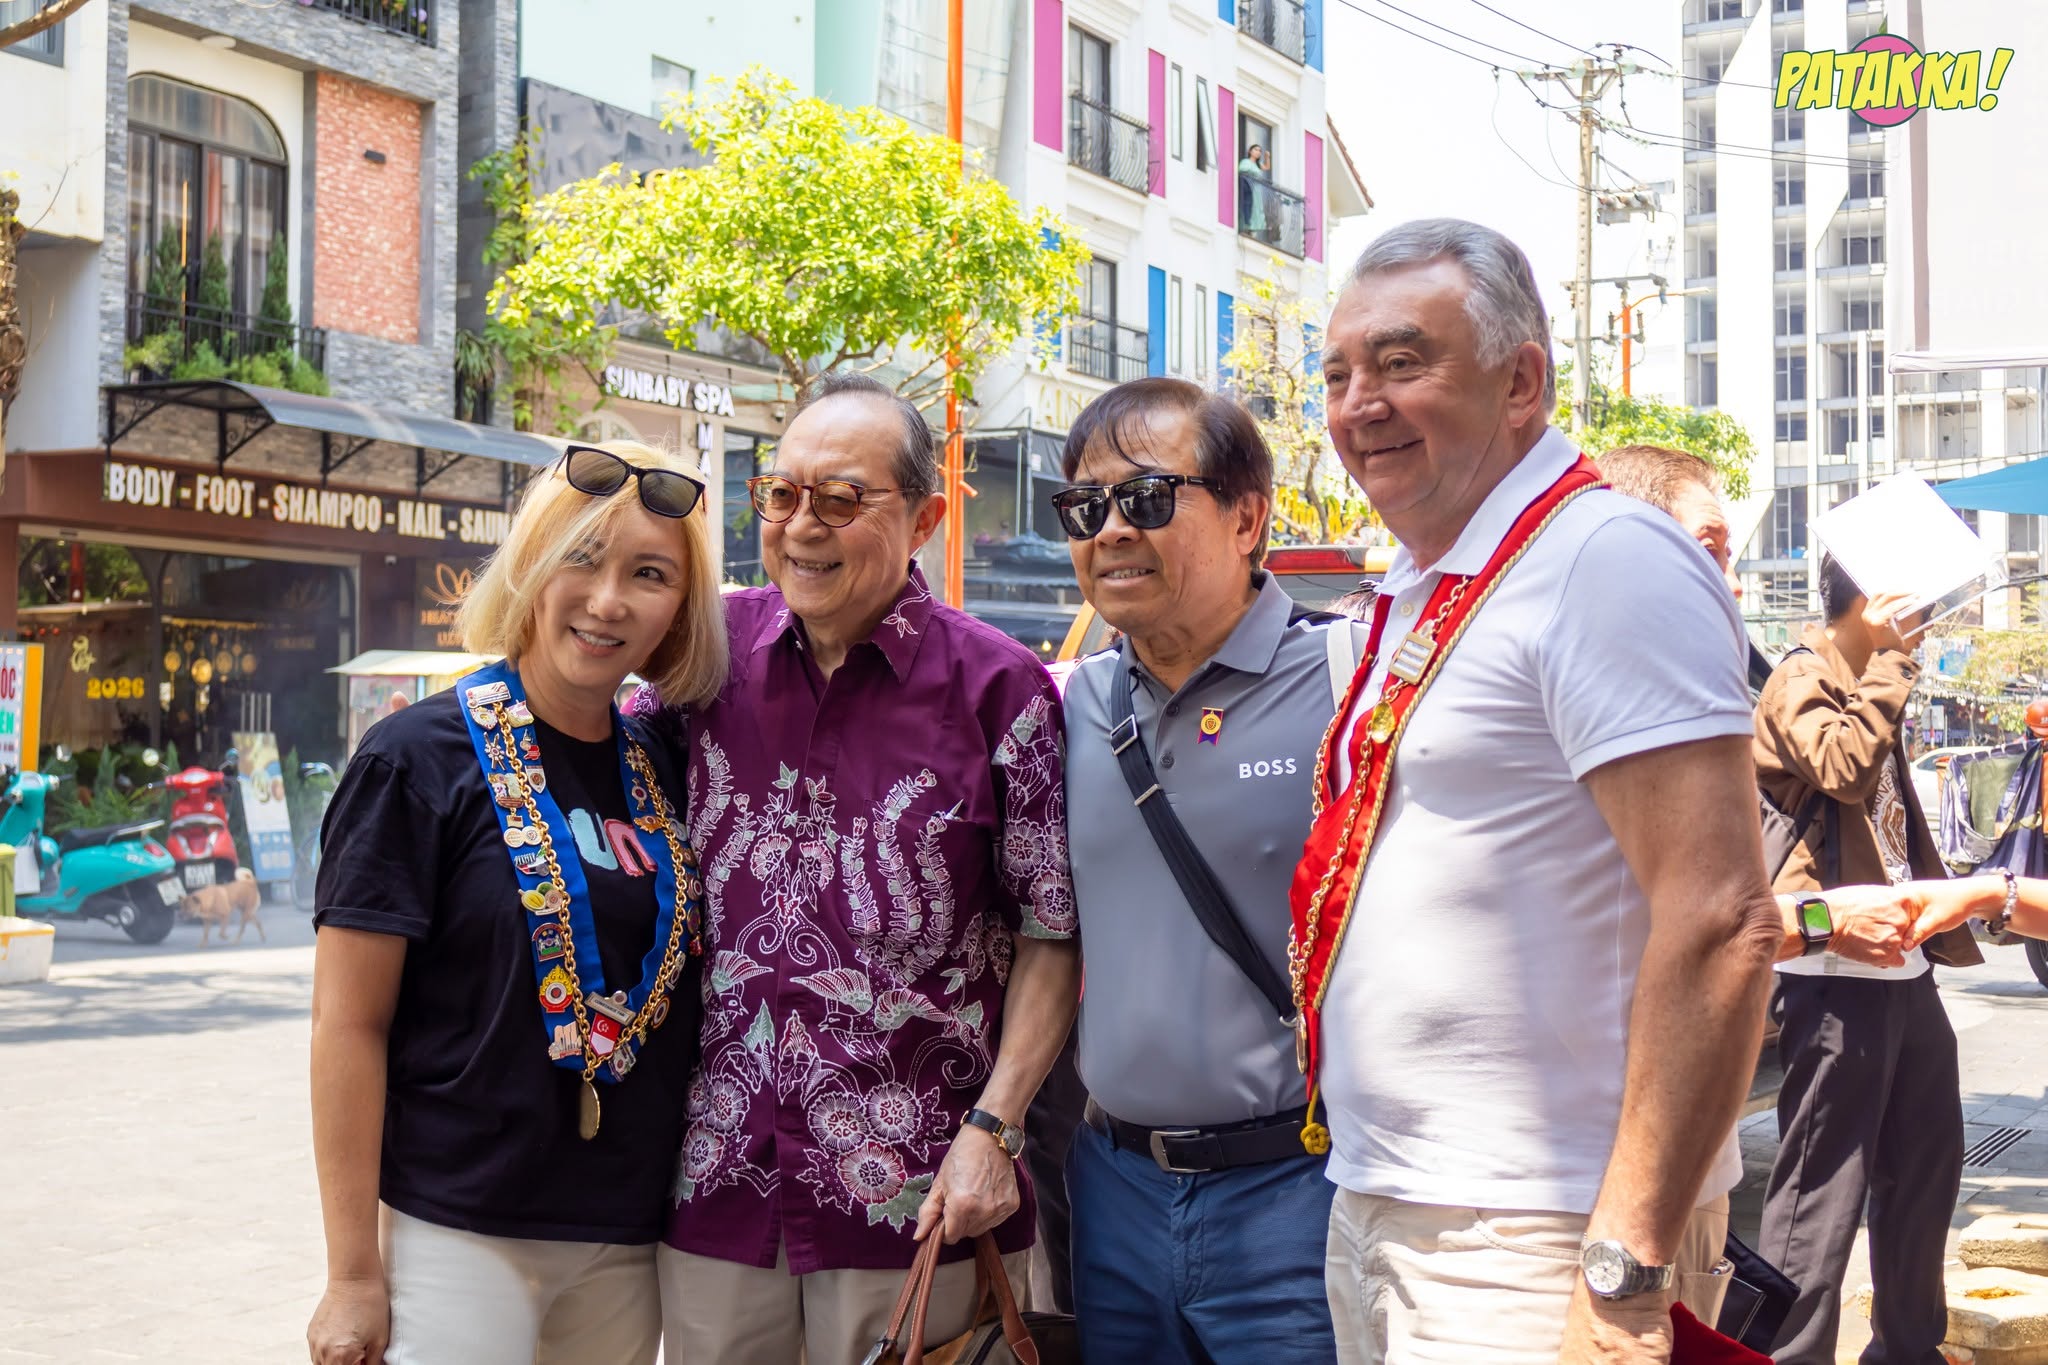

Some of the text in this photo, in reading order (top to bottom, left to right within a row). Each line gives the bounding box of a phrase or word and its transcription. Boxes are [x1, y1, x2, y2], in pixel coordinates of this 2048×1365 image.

[605, 365, 736, 417] SUNBABY SPA
[109, 463, 176, 508] BODY
[195, 474, 255, 518] FOOT
[273, 484, 382, 533] SHAMPOO
[398, 500, 446, 540] NAIL
[460, 507, 511, 545] SAUN
[86, 676, 145, 699] 2026
[1239, 758, 1297, 779] BOSS
